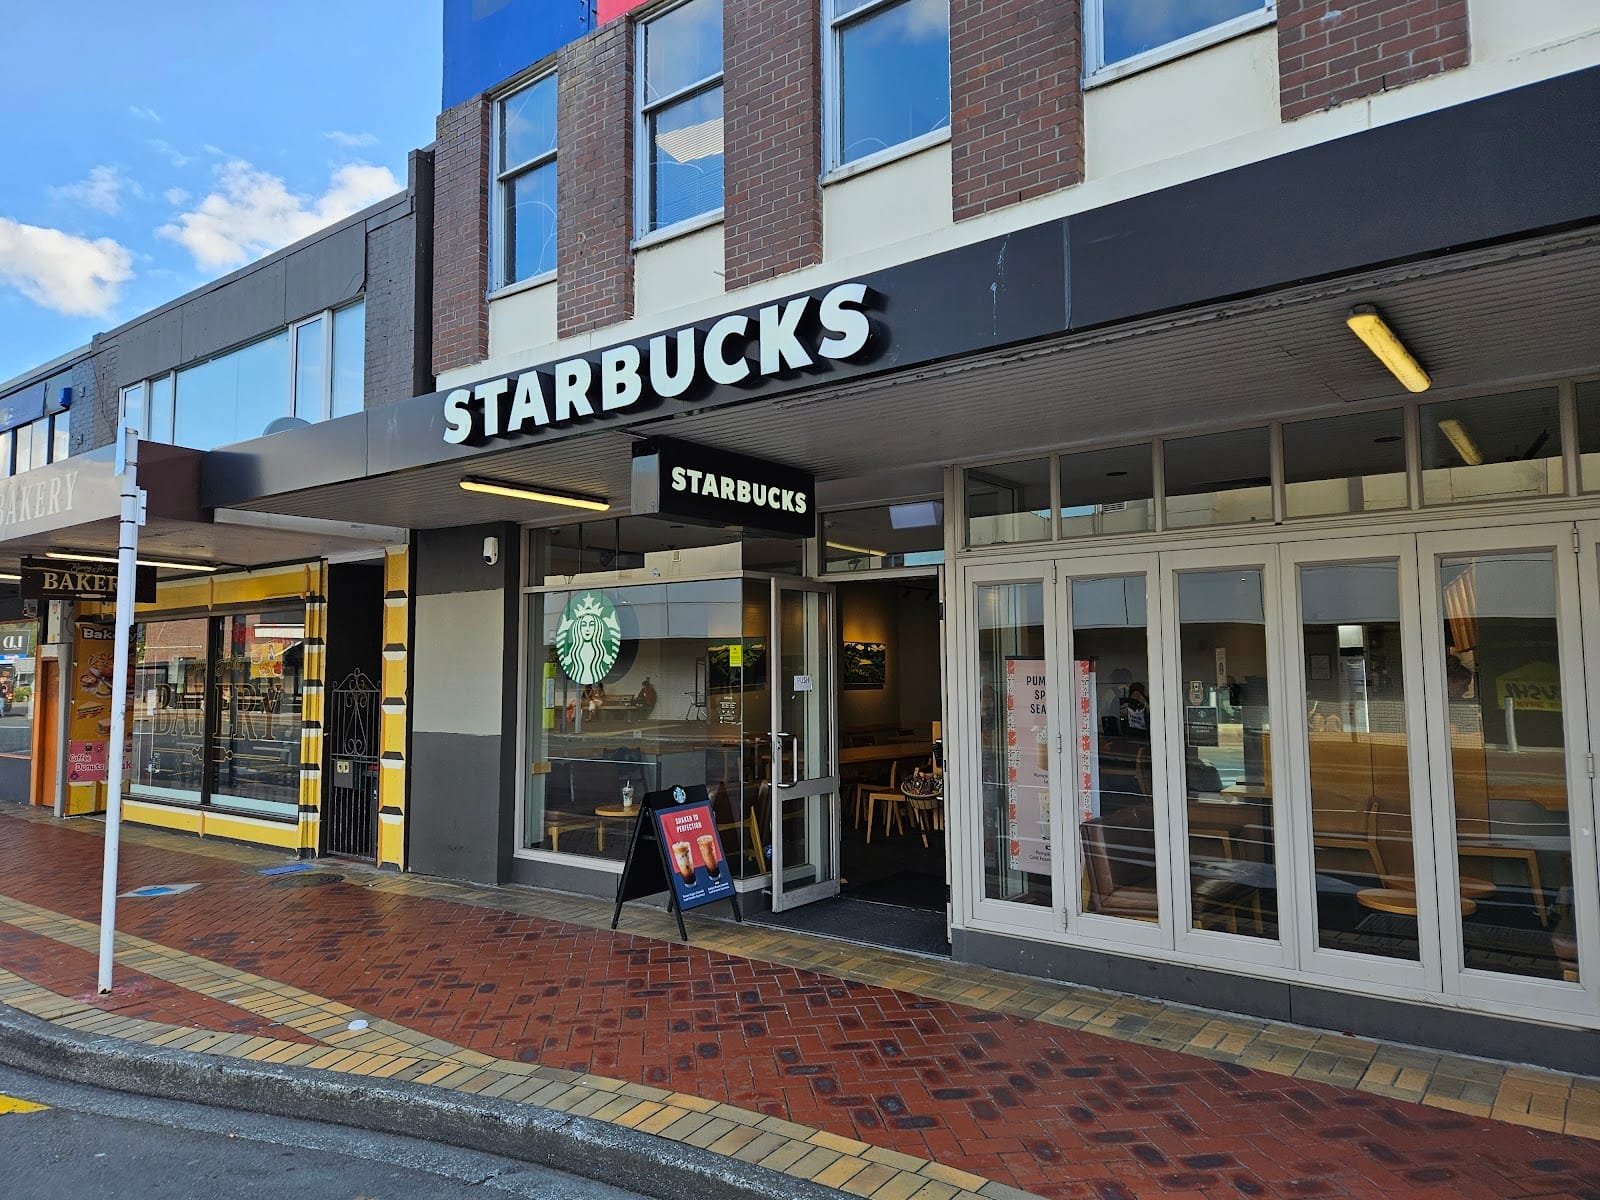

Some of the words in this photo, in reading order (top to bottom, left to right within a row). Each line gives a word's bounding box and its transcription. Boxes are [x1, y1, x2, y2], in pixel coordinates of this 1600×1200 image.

[443, 283, 870, 444] STARBUCKS
[672, 466, 807, 514] STARBUCKS
[83, 628, 137, 643] Baky
[1027, 676, 1046, 686] PUM
[1034, 690, 1046, 700] SP
[1030, 703, 1047, 715] SEA
[75, 763, 104, 772] Donuts
[676, 822, 702, 832] PERFECTION
